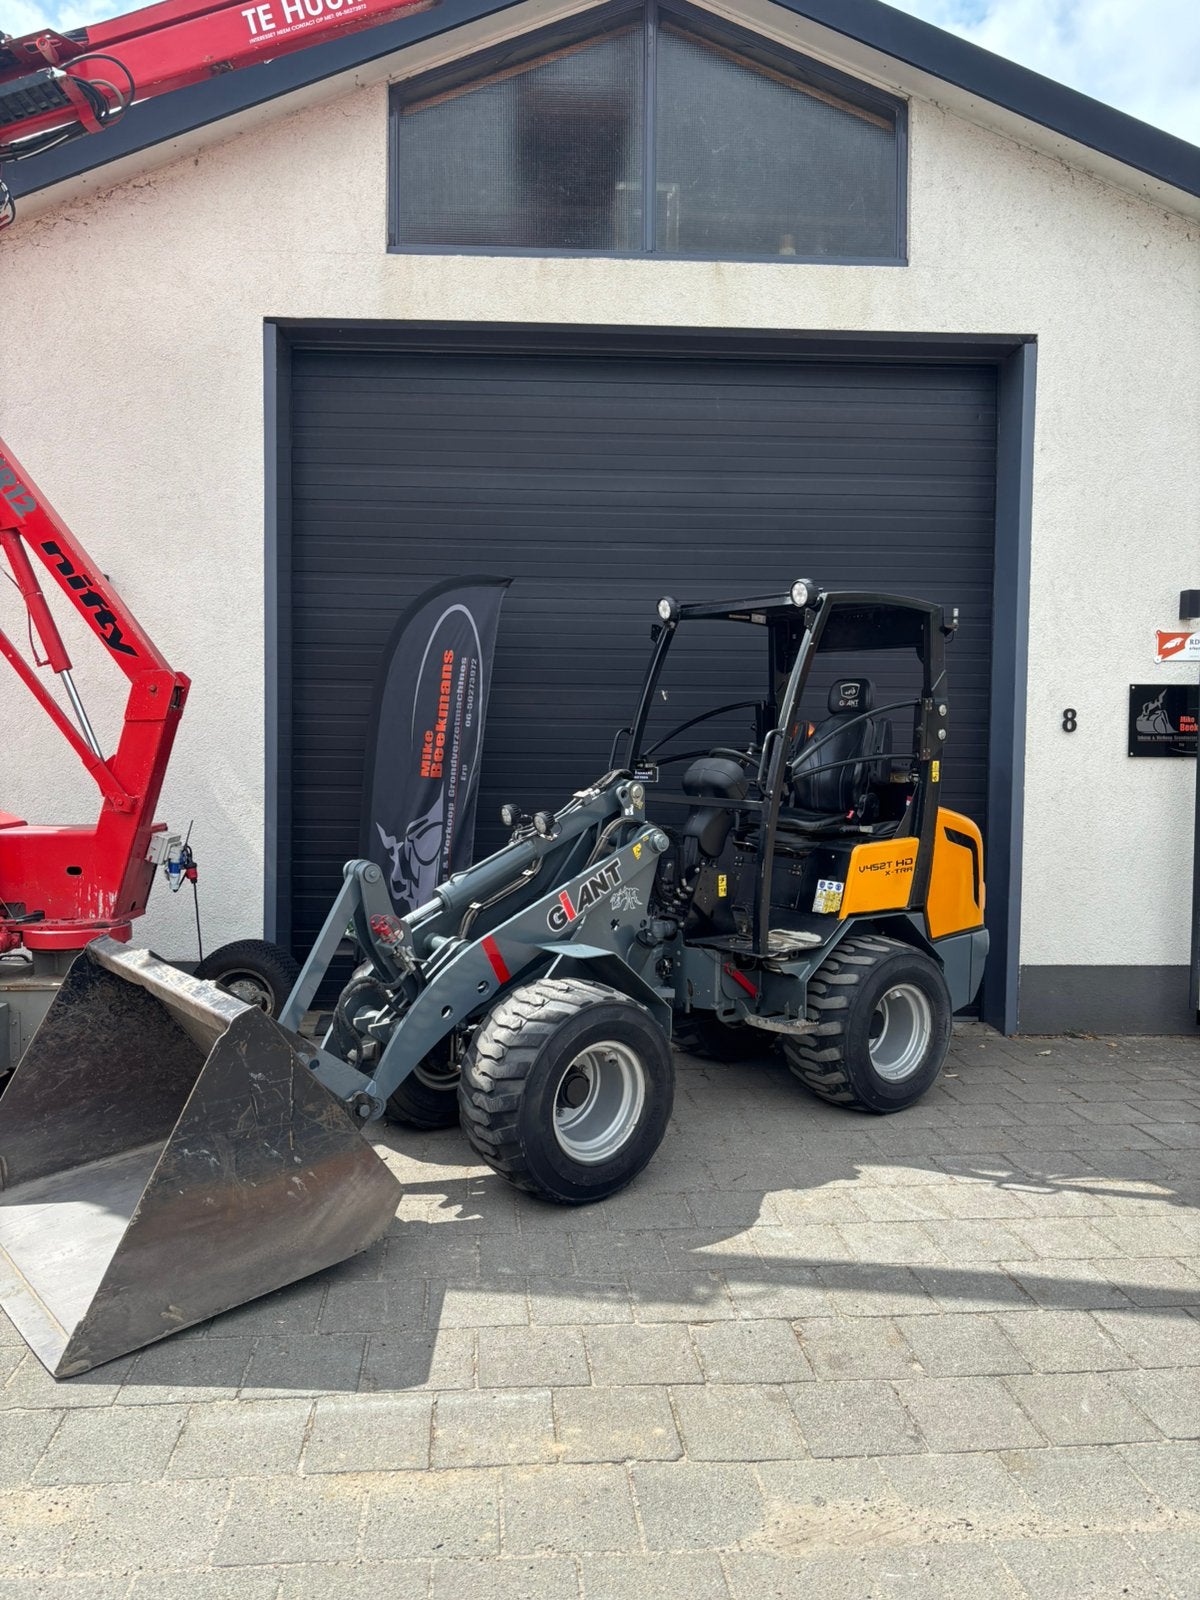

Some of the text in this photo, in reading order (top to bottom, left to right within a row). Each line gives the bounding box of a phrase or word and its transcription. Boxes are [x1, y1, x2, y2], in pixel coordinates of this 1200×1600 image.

[241, 3, 276, 35] TE
[276, 26, 291, 36] NEEM
[291, 19, 316, 31] CONTACT
[0, 456, 37, 518] R12
[40, 540, 139, 658] nifty
[430, 649, 454, 778] Beekmans
[448, 657, 467, 797] Grondverzetmachines
[1062, 708, 1078, 733] 8
[420, 730, 434, 777] Mike
[460, 764, 468, 781] Erp
[443, 802, 455, 855] Verkoop
[858, 857, 913, 873] V452T HD
[884, 866, 913, 876] X-TRA
[546, 857, 622, 933] GIANT
